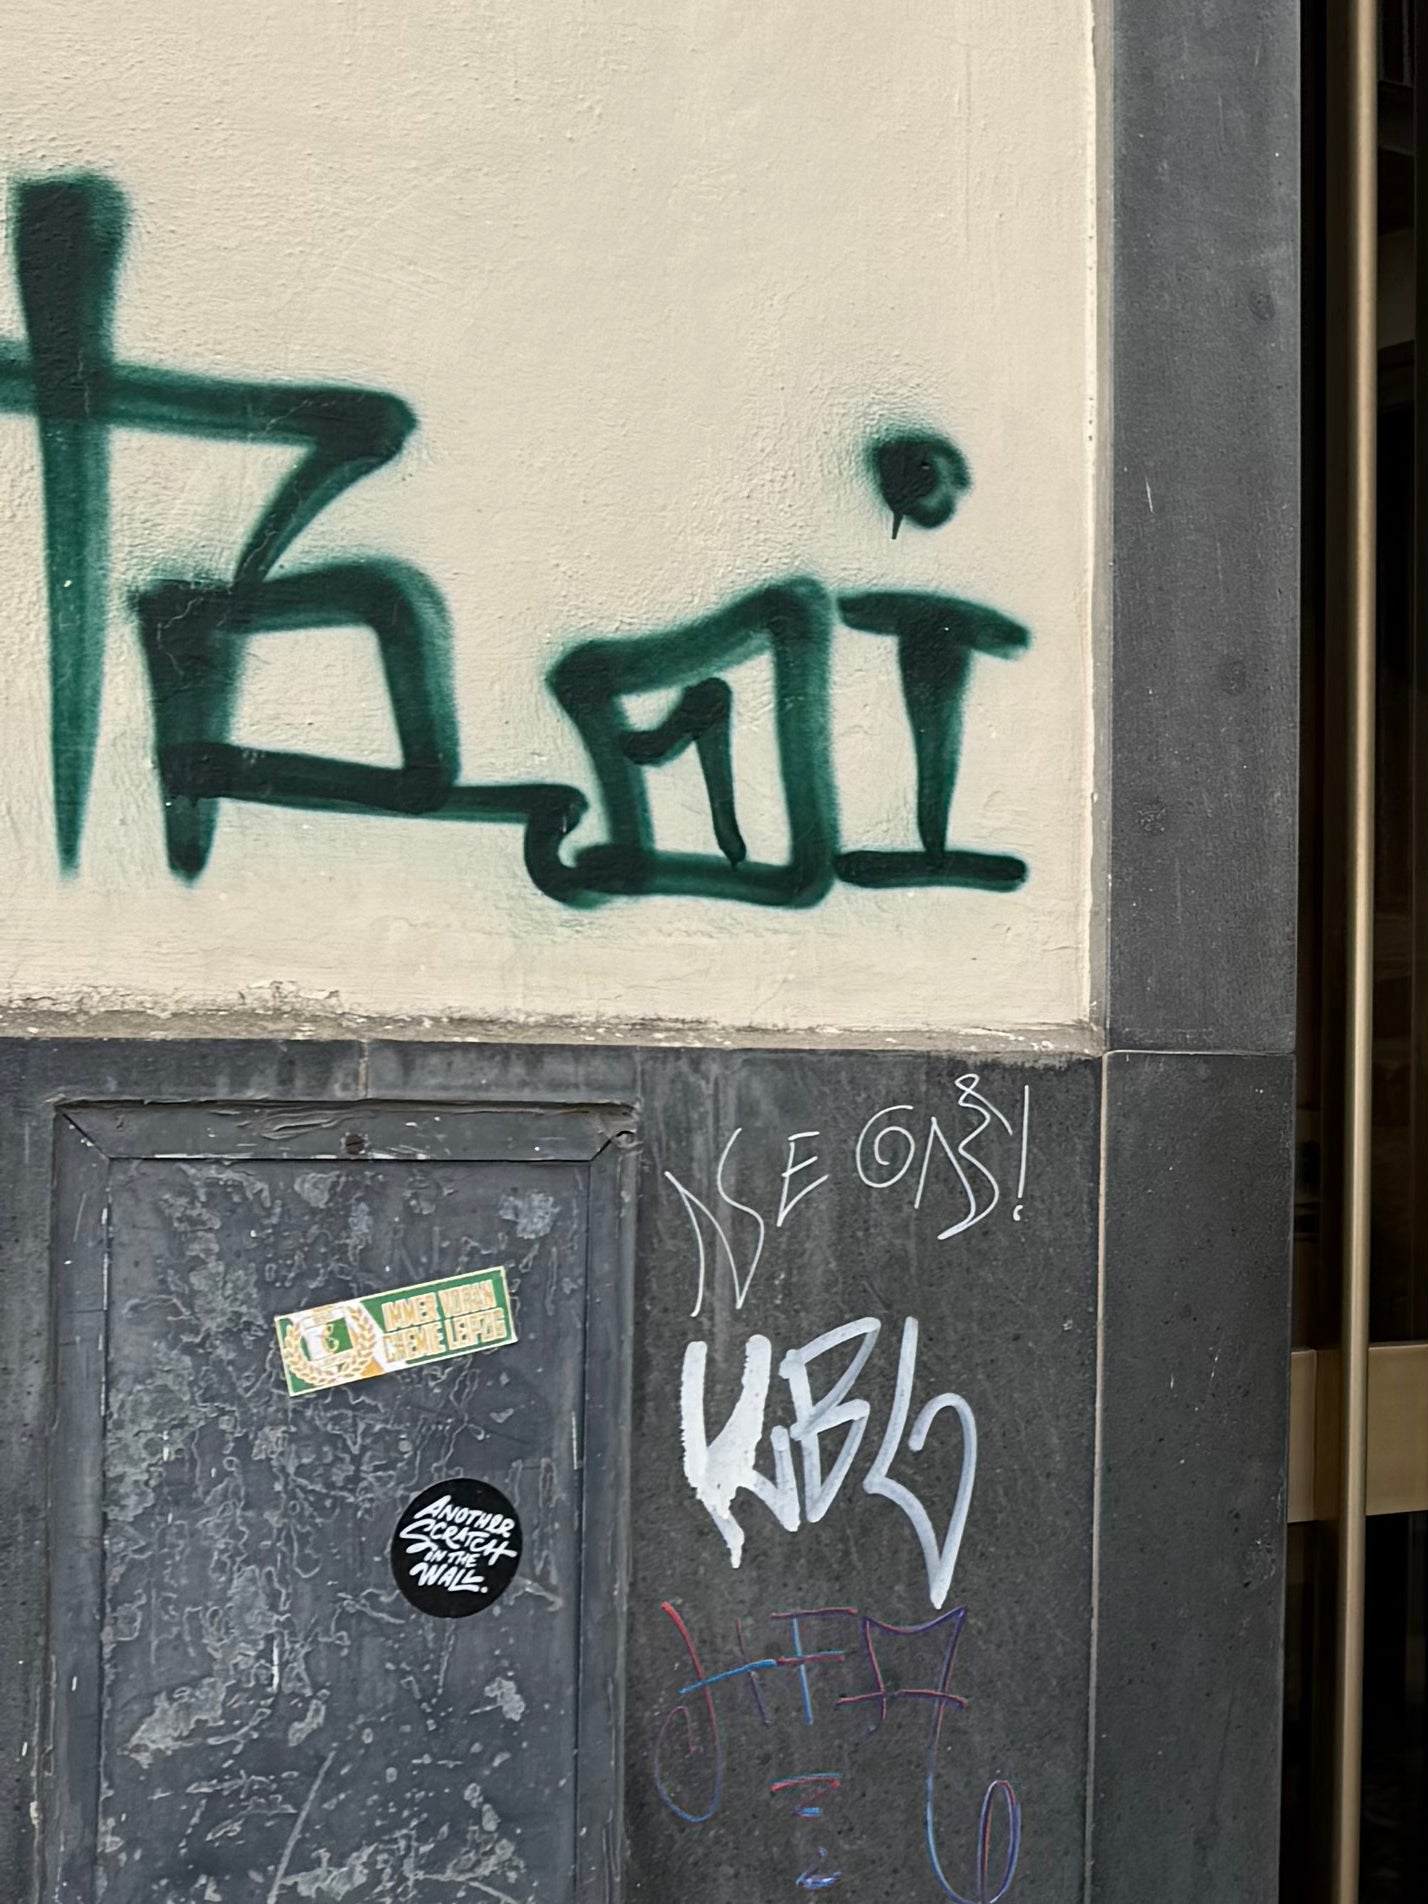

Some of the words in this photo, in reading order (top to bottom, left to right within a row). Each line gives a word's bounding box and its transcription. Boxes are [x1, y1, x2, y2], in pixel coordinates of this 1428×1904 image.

[381, 1291, 441, 1333] IMMER
[382, 1321, 447, 1364] CHEMIE
[444, 1306, 508, 1351] LEIPZIG
[413, 1494, 516, 1539] ANOTHER
[399, 1517, 518, 1566] SCRATCH
[424, 1549, 447, 1563] IN
[447, 1550, 481, 1568] THE
[409, 1561, 489, 1594] WALL.
